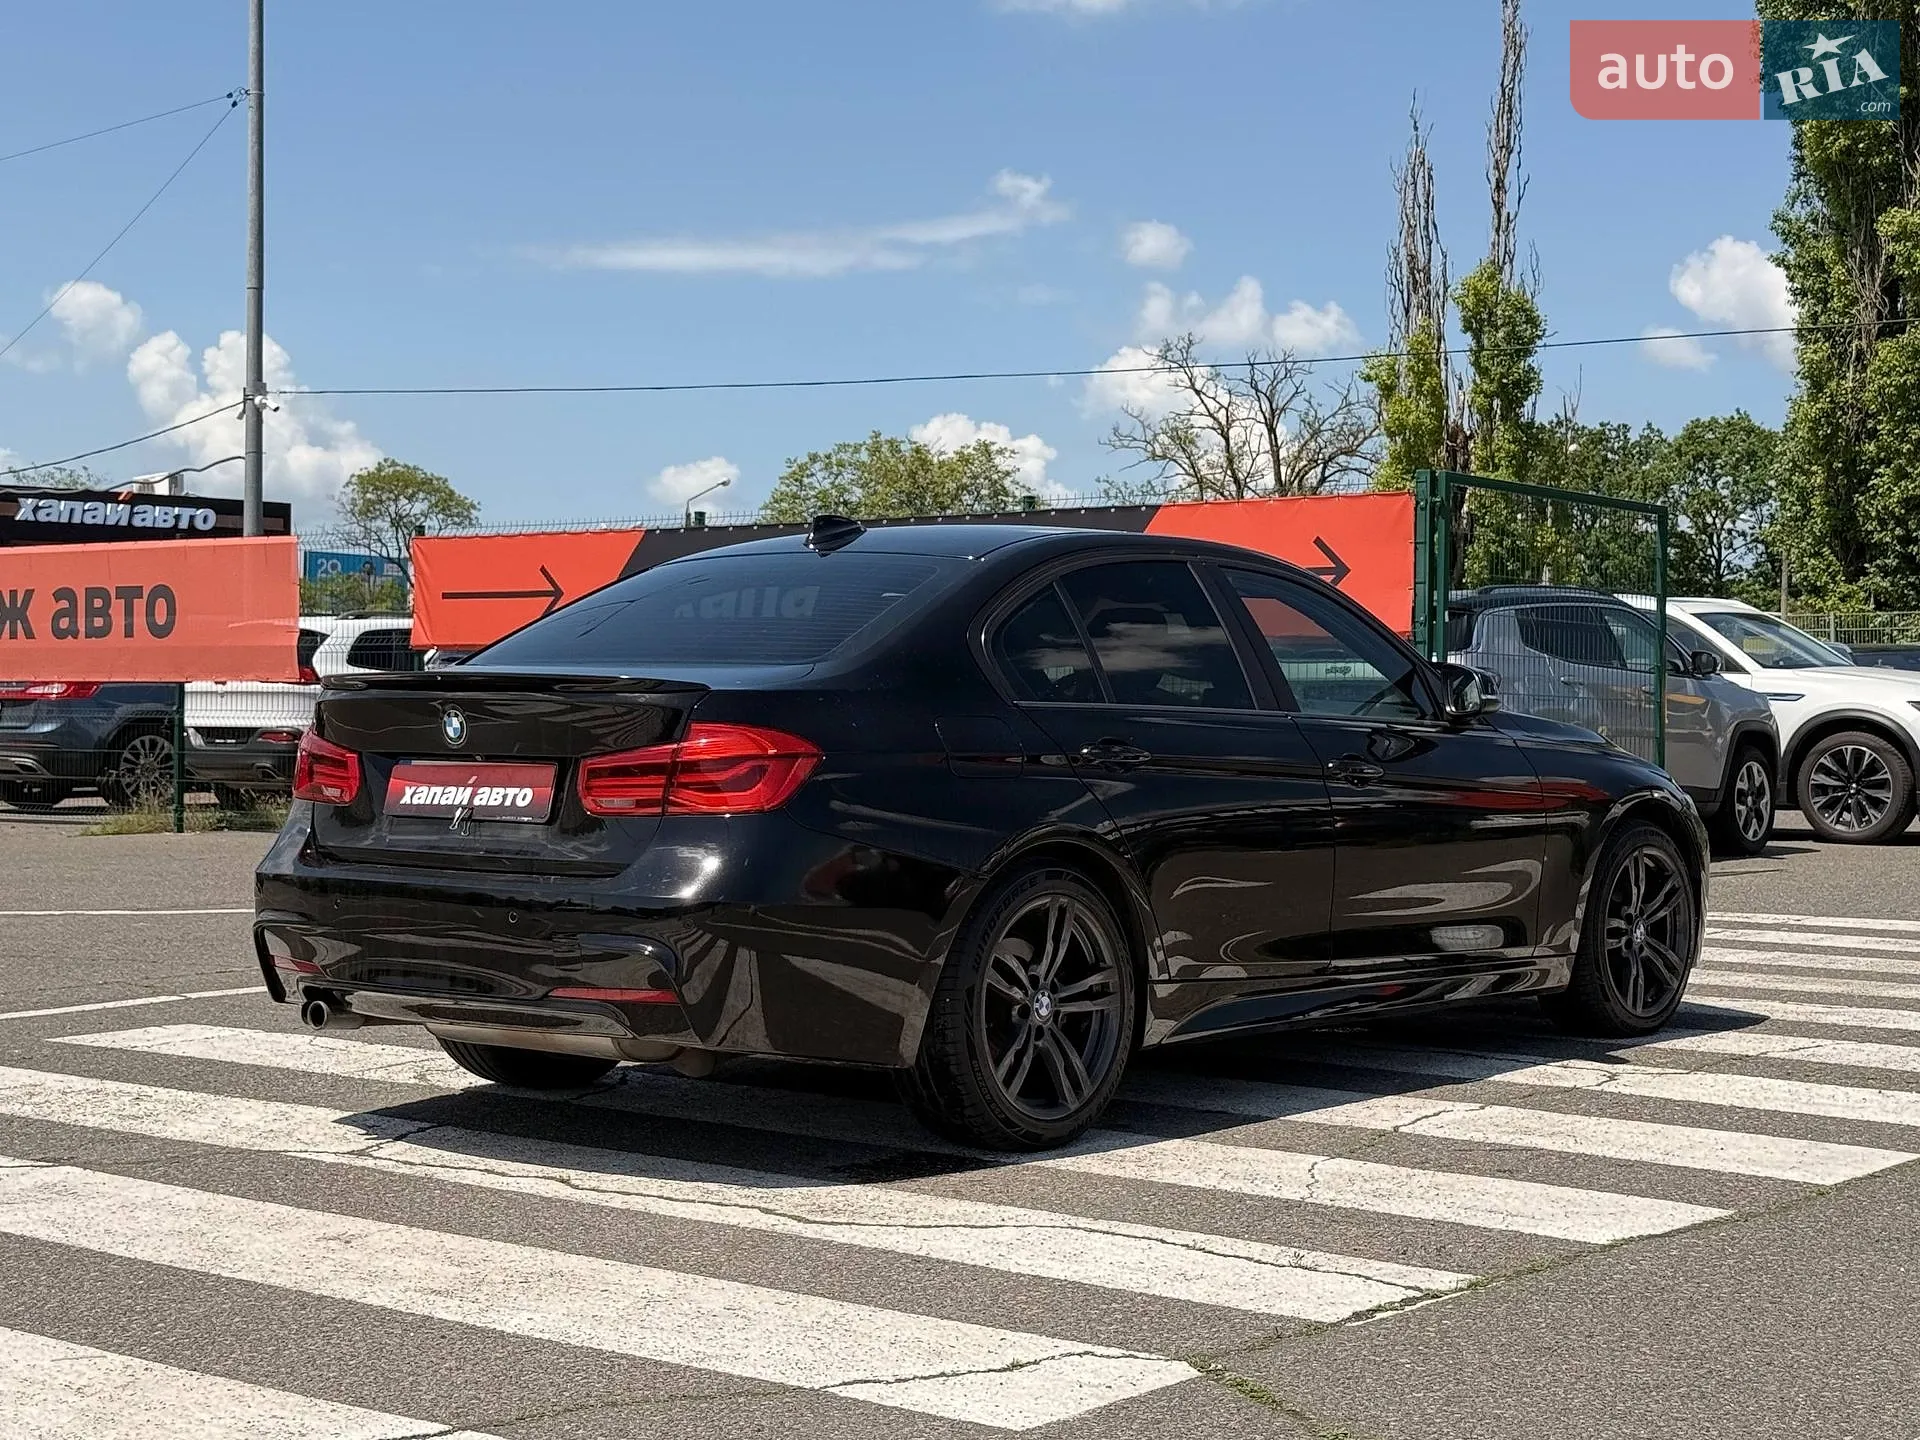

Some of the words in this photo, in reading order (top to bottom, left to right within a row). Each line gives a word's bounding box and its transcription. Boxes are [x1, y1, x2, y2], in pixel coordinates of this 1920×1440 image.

[14, 490, 134, 527] хапай
[131, 503, 217, 531] авто
[51, 583, 177, 640] авто
[400, 776, 477, 806] хапай
[473, 786, 534, 807] авто
